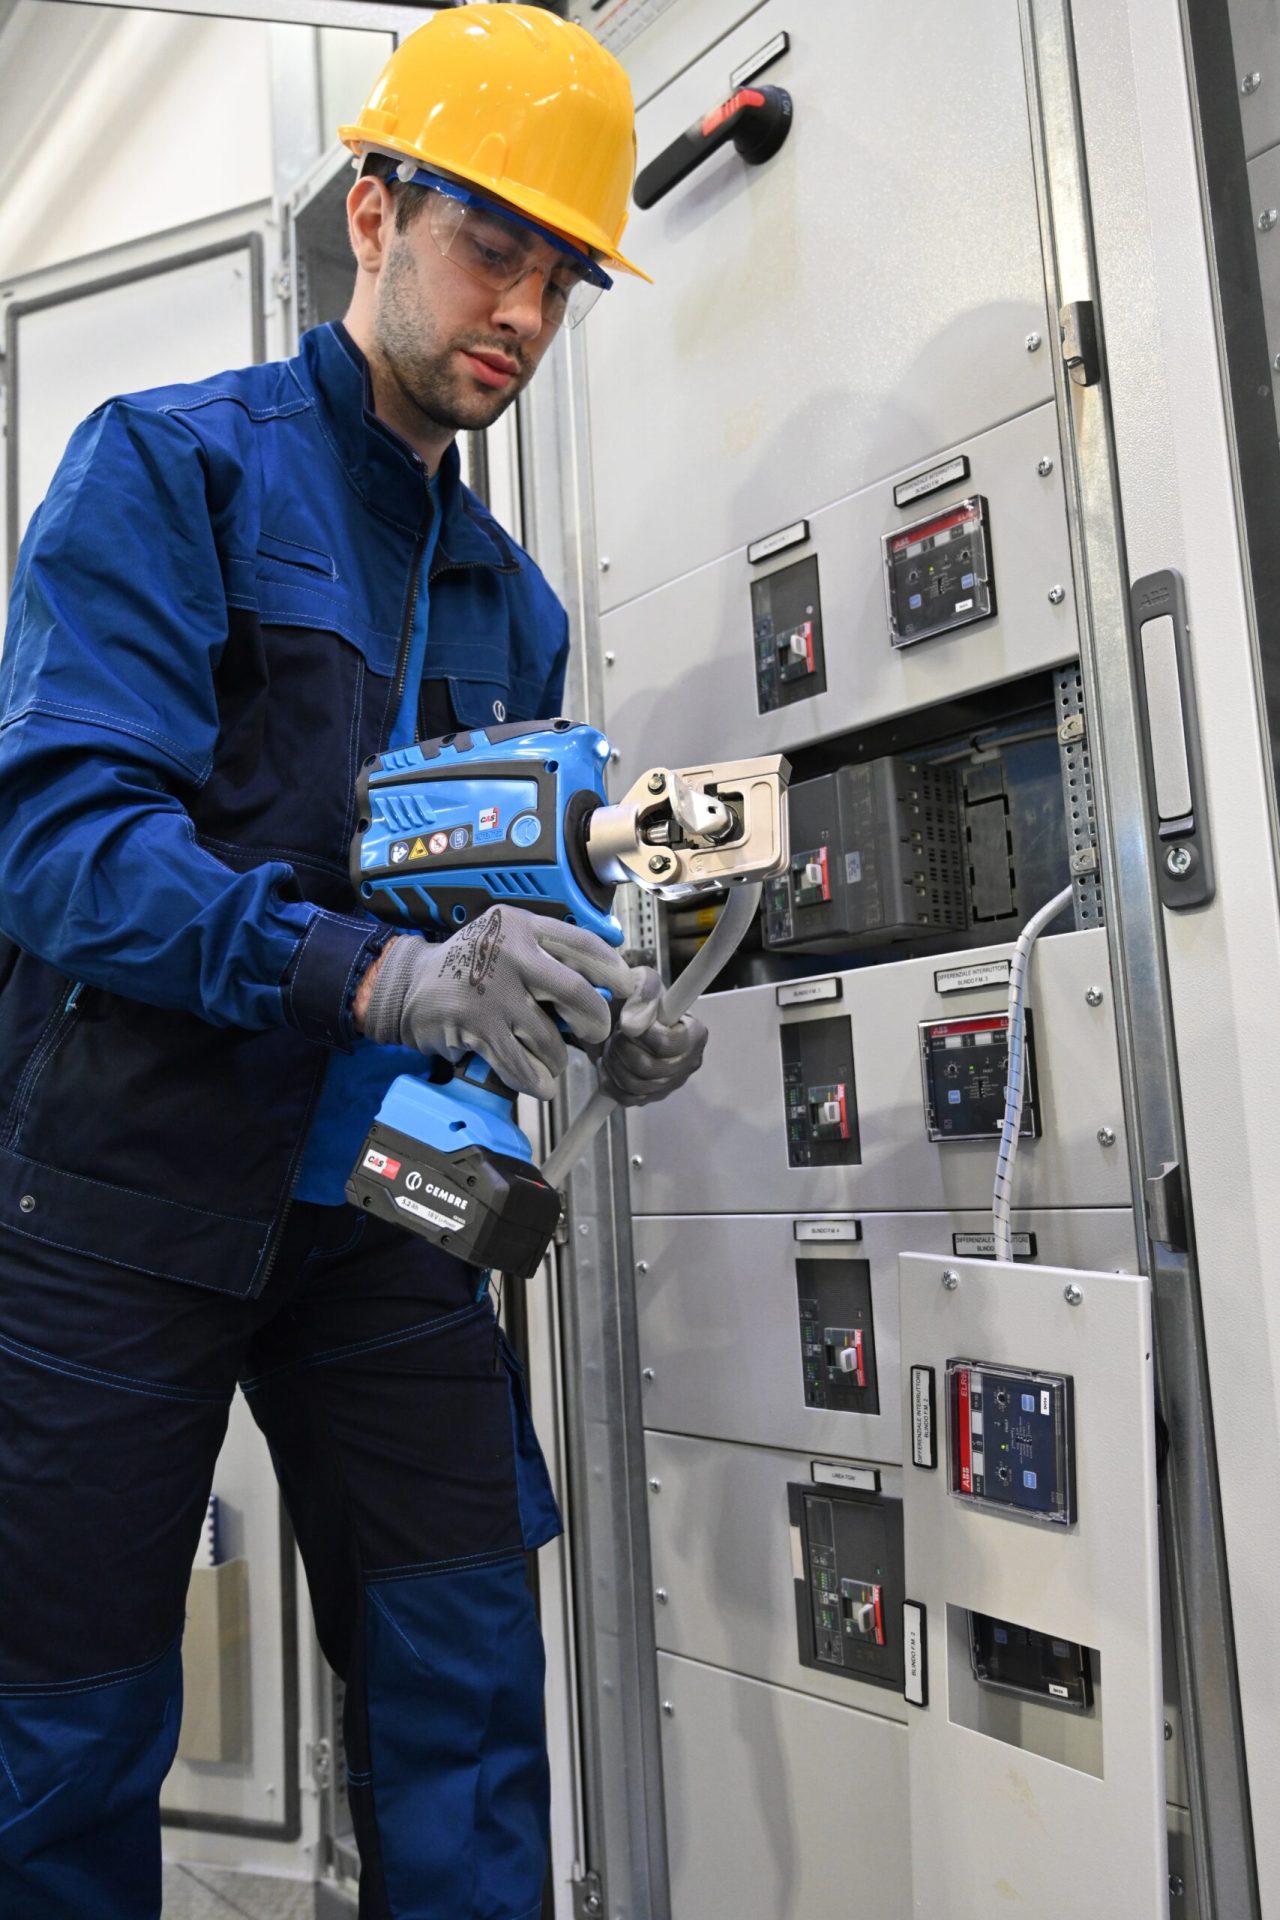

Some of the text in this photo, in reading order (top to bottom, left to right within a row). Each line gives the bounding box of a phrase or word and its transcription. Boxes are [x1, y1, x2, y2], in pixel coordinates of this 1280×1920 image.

[1139, 586, 1169, 610] ABB
[937, 964, 1008, 981] DIFFERENZIALE INTERRUTTORE
[367, 1155, 469, 1211] CAS CEMBRE
[961, 1467, 970, 1488] ABB
